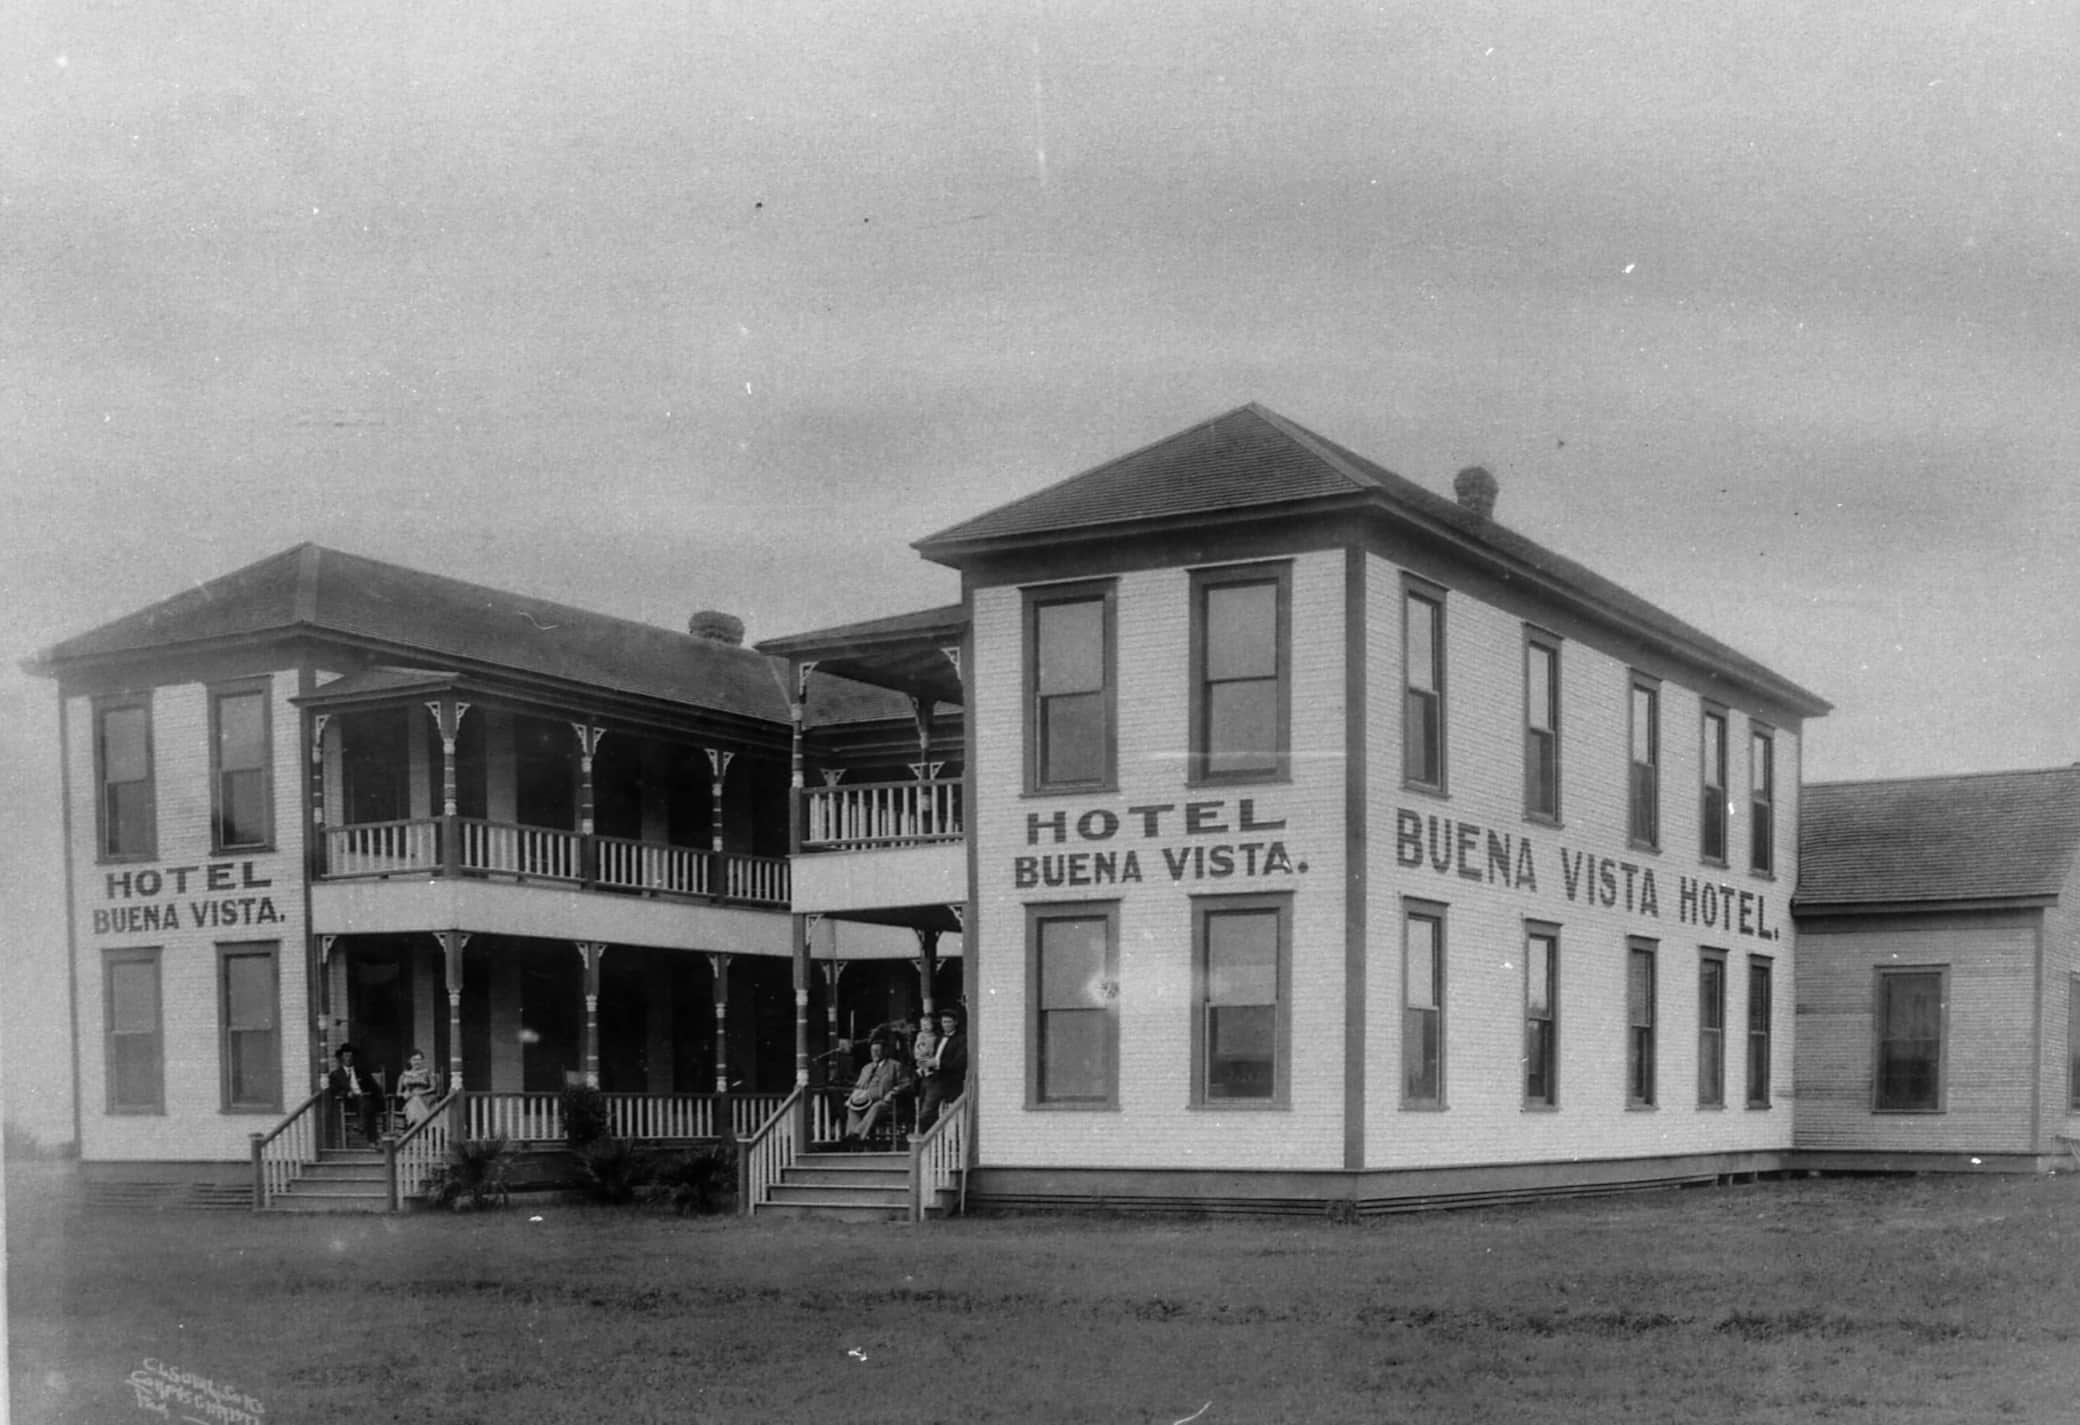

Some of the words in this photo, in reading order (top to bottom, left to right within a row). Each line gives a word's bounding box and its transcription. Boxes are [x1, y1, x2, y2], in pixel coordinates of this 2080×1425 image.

[1027, 799, 1286, 845] HOTEL
[106, 861, 272, 899] HOTEL
[1015, 850, 1143, 889] BUENA
[1160, 841, 1309, 882] VISTA.
[1397, 808, 1537, 893] BUENA
[1561, 847, 1659, 918] VISTA
[93, 903, 180, 934] BUENA
[190, 897, 286, 929] VISTA.
